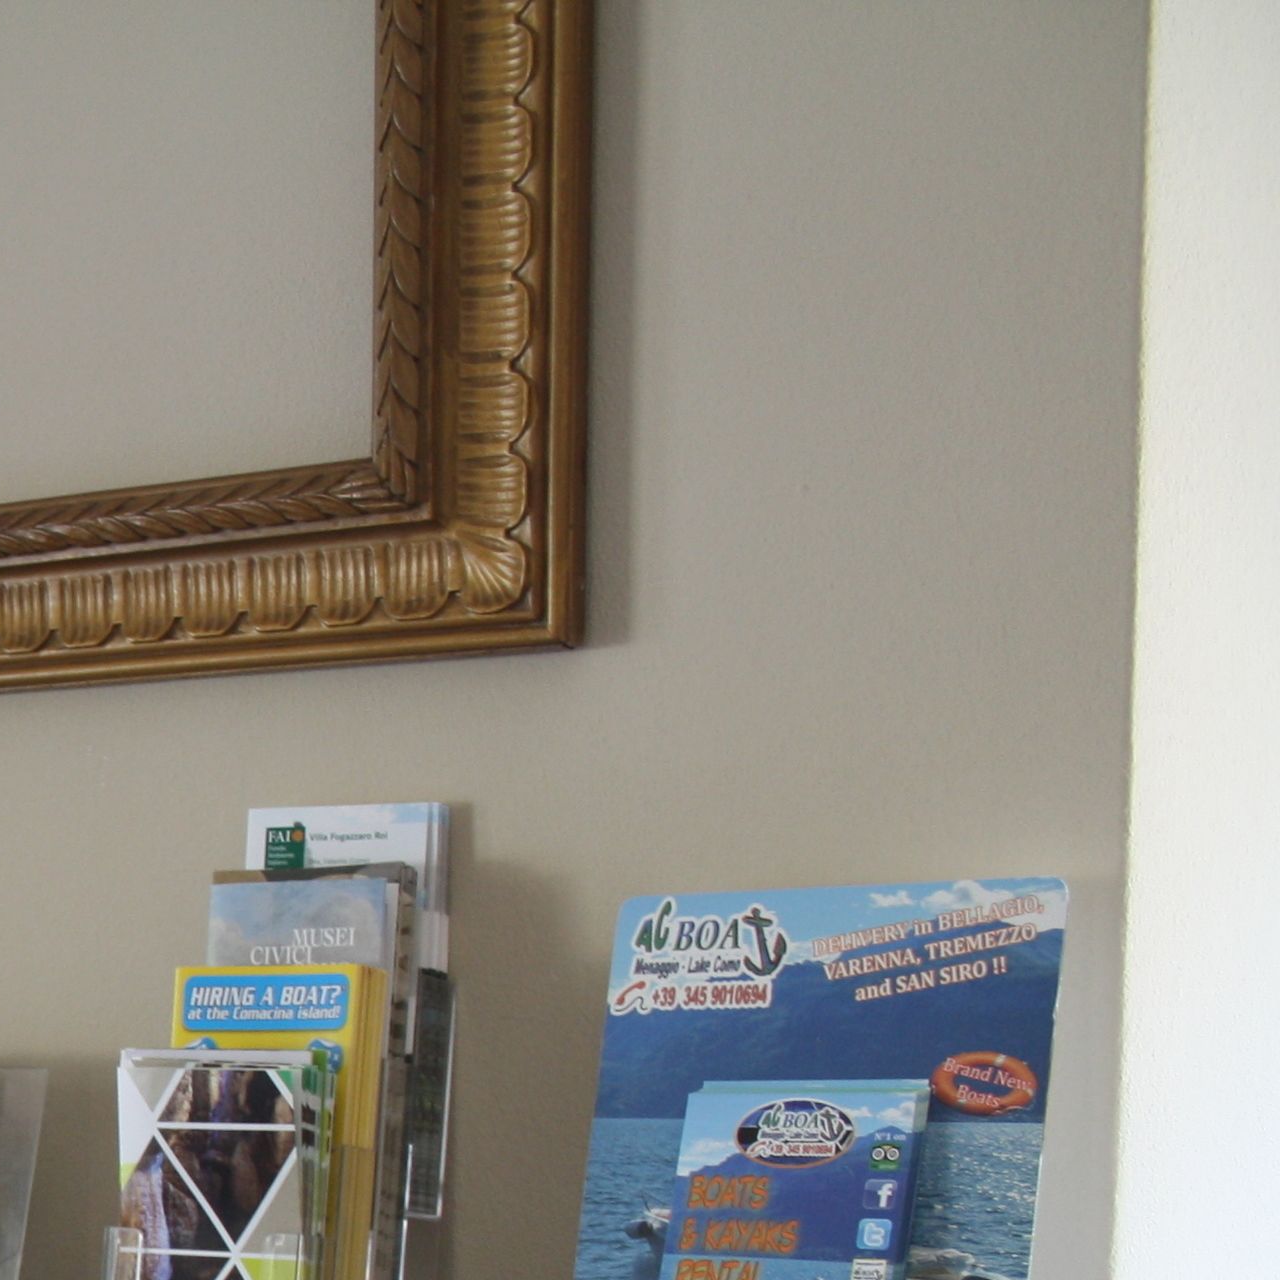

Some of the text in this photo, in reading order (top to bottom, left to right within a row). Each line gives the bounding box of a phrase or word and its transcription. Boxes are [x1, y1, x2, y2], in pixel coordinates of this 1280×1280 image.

[267, 830, 292, 844] FAI
[291, 926, 356, 948] MUSEI
[811, 894, 1045, 957] DELIVERY in BELLAGIO,
[249, 946, 313, 966] CIVICI
[823, 922, 1038, 981] VARENNA, TREMEZZO
[687, 956, 711, 974] Lake
[854, 980, 893, 1002] and
[895, 970, 935, 994] SAN
[939, 960, 988, 985] SIRO
[191, 985, 342, 1007] HIRING A BOAT?
[652, 984, 768, 1006] +39 345 9010694
[187, 1005, 341, 1021] at the Comacina island!
[942, 1056, 1035, 1095] Brand New
[956, 1084, 1001, 1109] Boats
[688, 1173, 770, 1210] BOATS
[703, 1218, 801, 1253] KAYAKS
